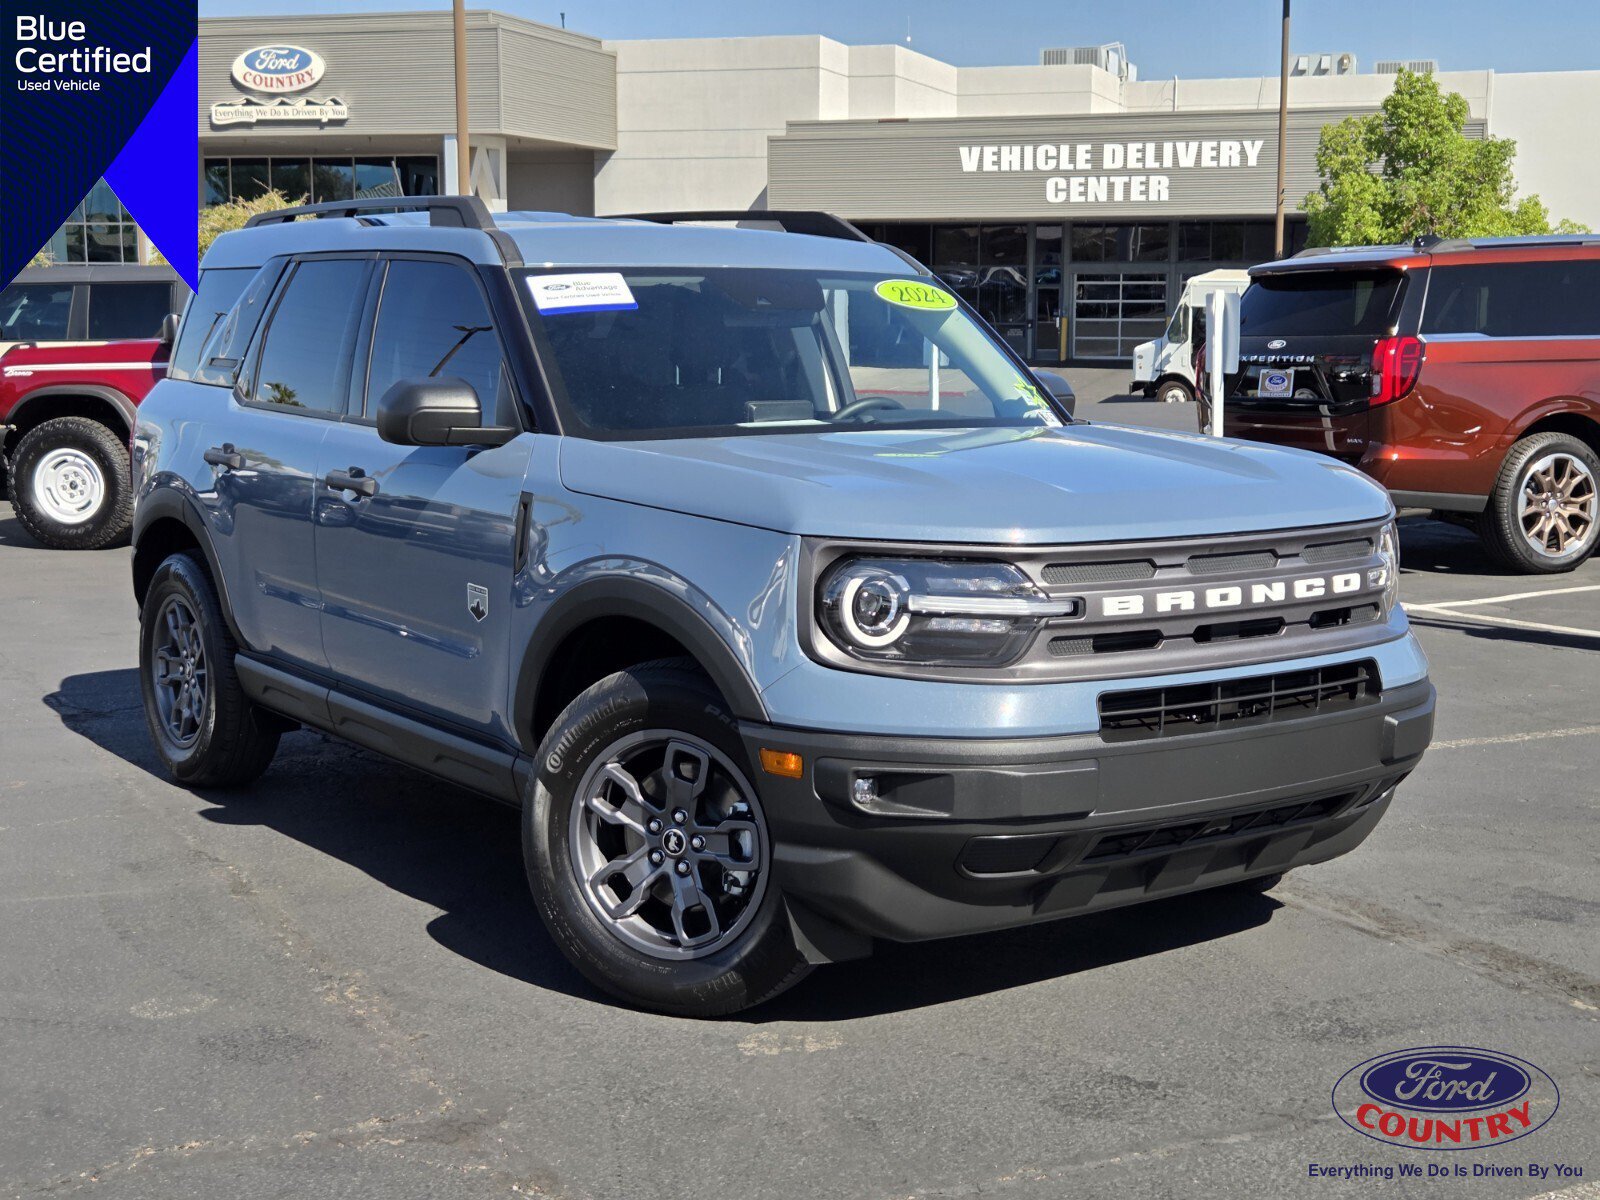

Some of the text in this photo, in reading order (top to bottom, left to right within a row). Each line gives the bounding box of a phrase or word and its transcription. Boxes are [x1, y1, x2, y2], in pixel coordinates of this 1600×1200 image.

[255, 48, 301, 70] Ford
[242, 69, 316, 88] COUNTRY
[214, 107, 346, 119] Everything We Do Is Driven By You
[958, 140, 1263, 172] VEHICLE DELIVERY
[1045, 175, 1170, 203] CENTER
[891, 286, 946, 304] 2024
[1102, 572, 1361, 616] BRONCO
